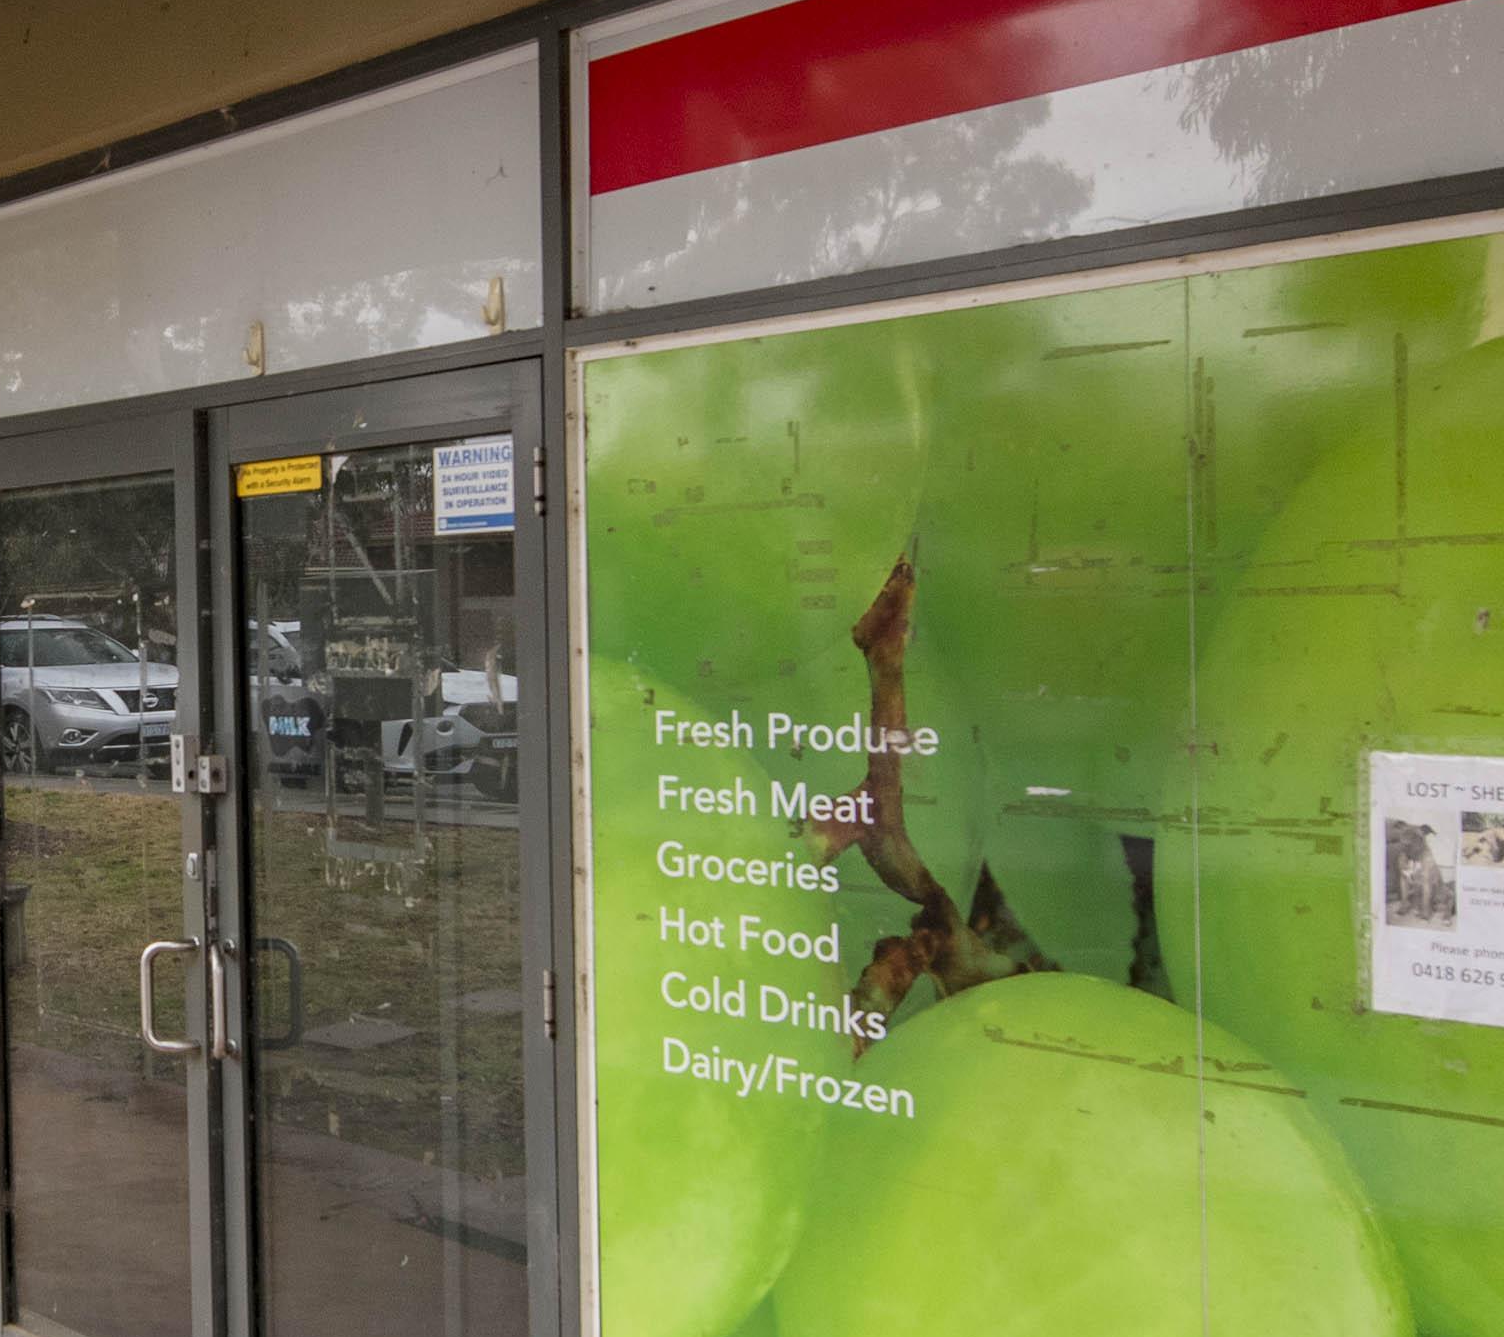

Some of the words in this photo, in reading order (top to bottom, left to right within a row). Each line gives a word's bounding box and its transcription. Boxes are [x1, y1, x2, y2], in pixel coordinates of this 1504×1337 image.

[438, 445, 512, 466] WARNING
[253, 466, 279, 475] Property
[287, 462, 319, 471] Protected
[441, 474, 451, 483] 24
[454, 471, 479, 481] HOUR
[482, 469, 508, 479] VIDEO
[246, 481, 259, 490] with
[266, 478, 291, 487] Security
[293, 477, 311, 485] Alarm
[442, 483, 508, 496] SURVEILLANCE
[444, 501, 453, 509] IN
[456, 497, 506, 508] OPERATION
[655, 710, 754, 749] Fresh
[658, 775, 757, 816] Fresh
[770, 780, 875, 825] Meat
[1407, 782, 1450, 798] LOST
[657, 840, 840, 892] Groceries
[659, 906, 725, 949] Hot
[739, 915, 840, 963] Food
[1430, 941, 1470, 956] Please
[1412, 962, 1455, 981] 0418
[1461, 967, 1496, 986] 626
[661, 972, 745, 1018] Cold
[759, 985, 887, 1040] Drinks
[662, 1037, 915, 1118] Dairy/Frozen
